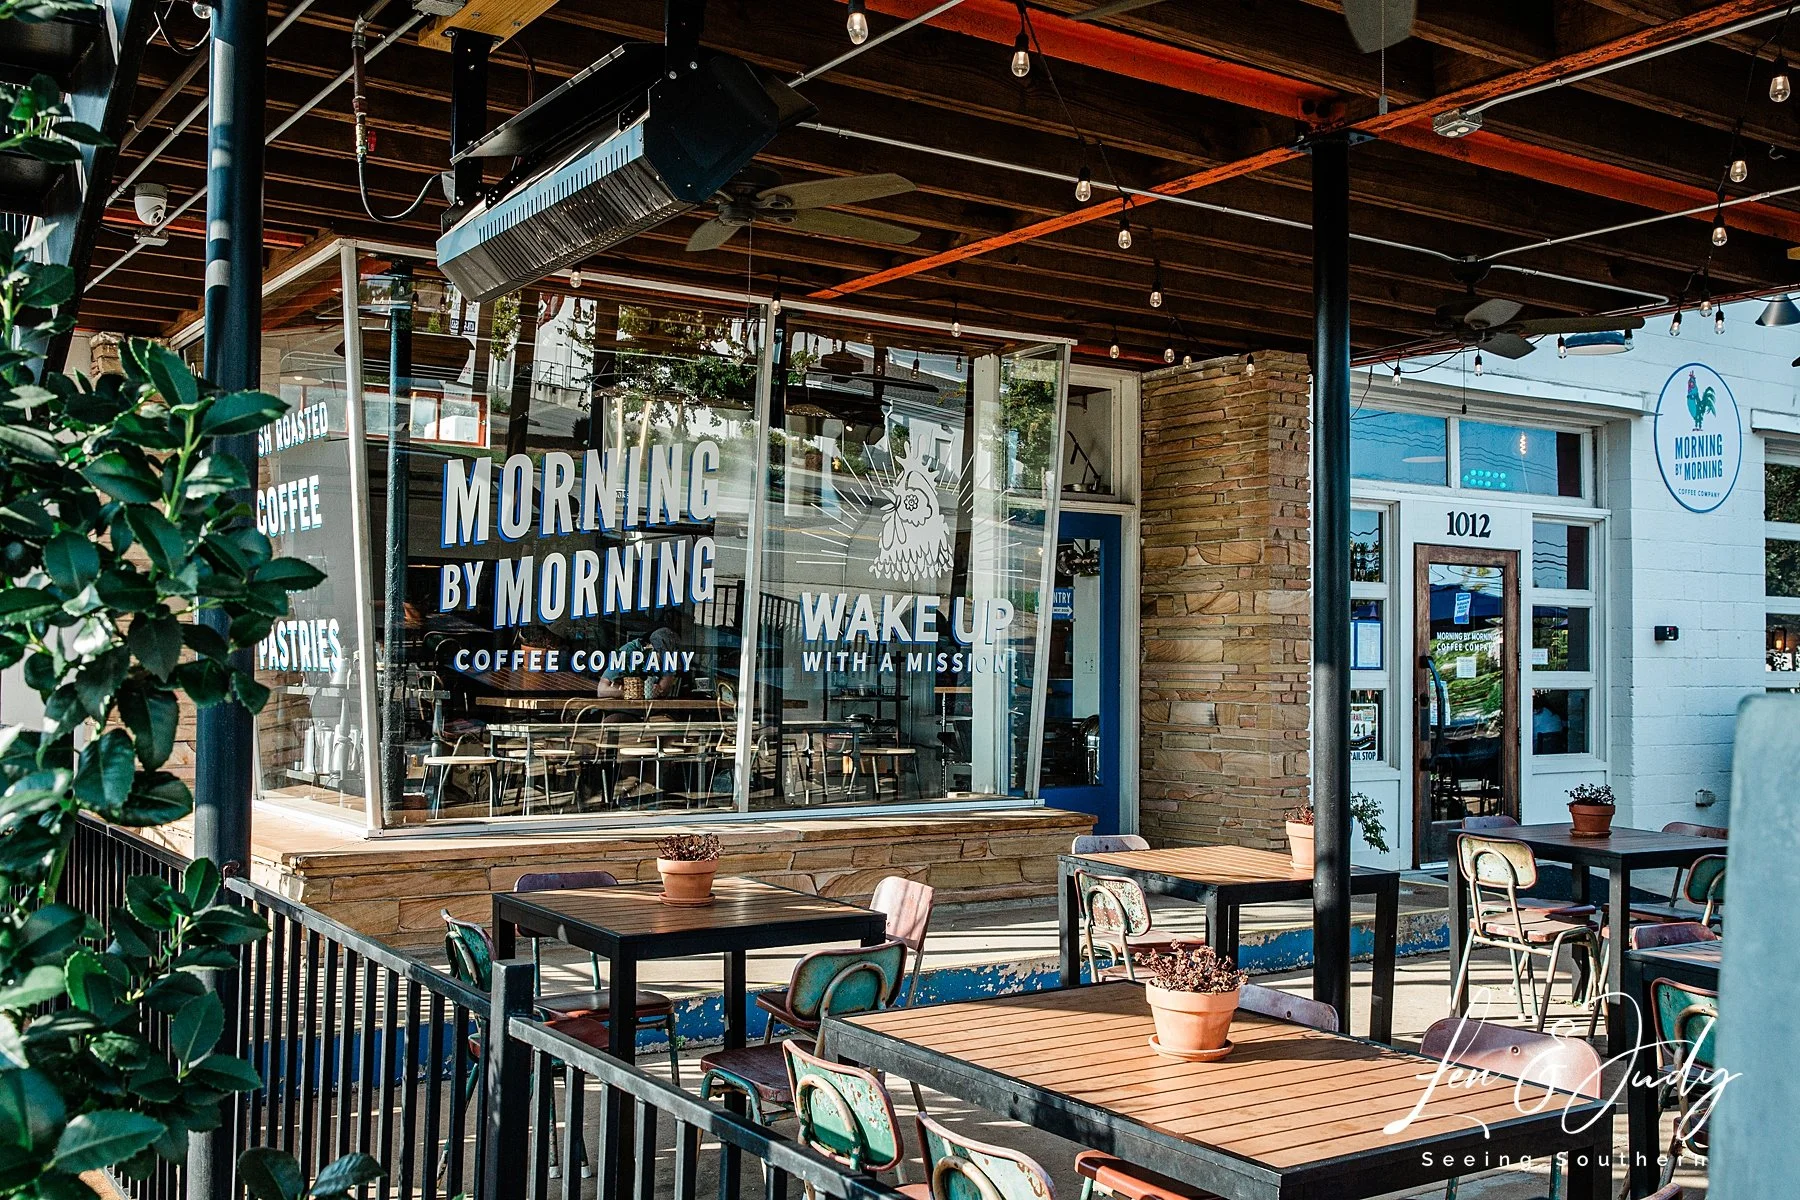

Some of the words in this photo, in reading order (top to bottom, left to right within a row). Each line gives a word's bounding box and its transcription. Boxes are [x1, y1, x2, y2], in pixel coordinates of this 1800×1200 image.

[257, 423, 273, 458] SH
[275, 401, 329, 451] ROASTED
[1675, 433, 1723, 460] MORNING
[1675, 463, 1682, 476] BY
[1684, 459, 1723, 480] MORNING
[256, 474, 323, 538] COFFEE
[440, 440, 720, 549] MORNING
[1678, 488, 1697, 497] COFFEE
[1698, 490, 1720, 499] COMPANY
[1446, 510, 1492, 539] 1012
[439, 561, 484, 613] BY
[493, 536, 715, 629] MORNING
[801, 592, 940, 645] WAKE
[952, 596, 1015, 646] UP
[258, 618, 342, 673] PASTRIES
[1436, 631, 1463, 641] MORNING
[1463, 632, 1471, 641] BY
[1436, 643, 1463, 652] COFFEE
[453, 649, 560, 673] COFFEE
[570, 649, 696, 674] COMPANY
[802, 652, 867, 673] WITH
[879, 652, 895, 673] A
[906, 652, 1006, 674] MISSION
[1353, 723, 1366, 737] 41
[1362, 751, 1377, 761] STOP
